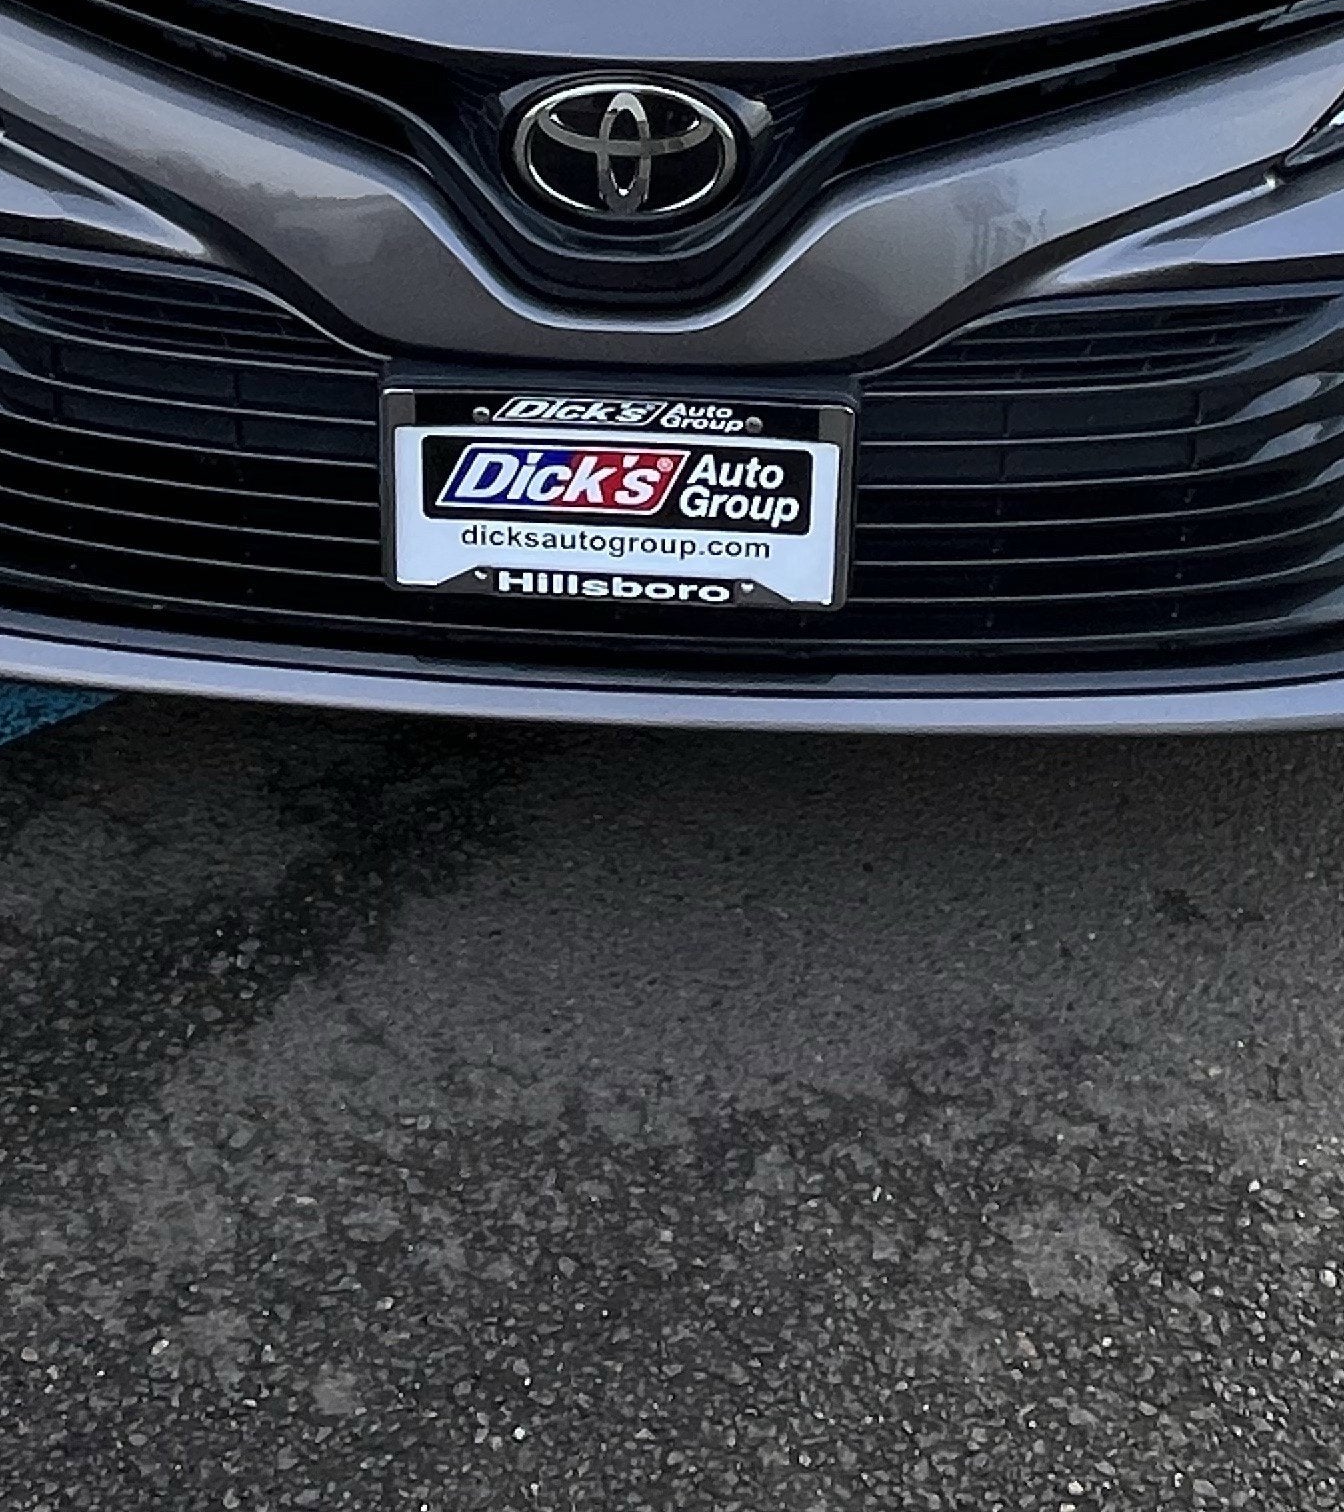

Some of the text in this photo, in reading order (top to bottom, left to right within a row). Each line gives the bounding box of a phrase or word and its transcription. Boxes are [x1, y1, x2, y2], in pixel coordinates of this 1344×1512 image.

[660, 415, 744, 433] Group
[667, 402, 734, 418] Auto
[687, 454, 785, 490] Auto
[679, 486, 800, 528] Group
[461, 525, 771, 559] dicksautogroup.com
[497, 569, 731, 603] Hillsboro
